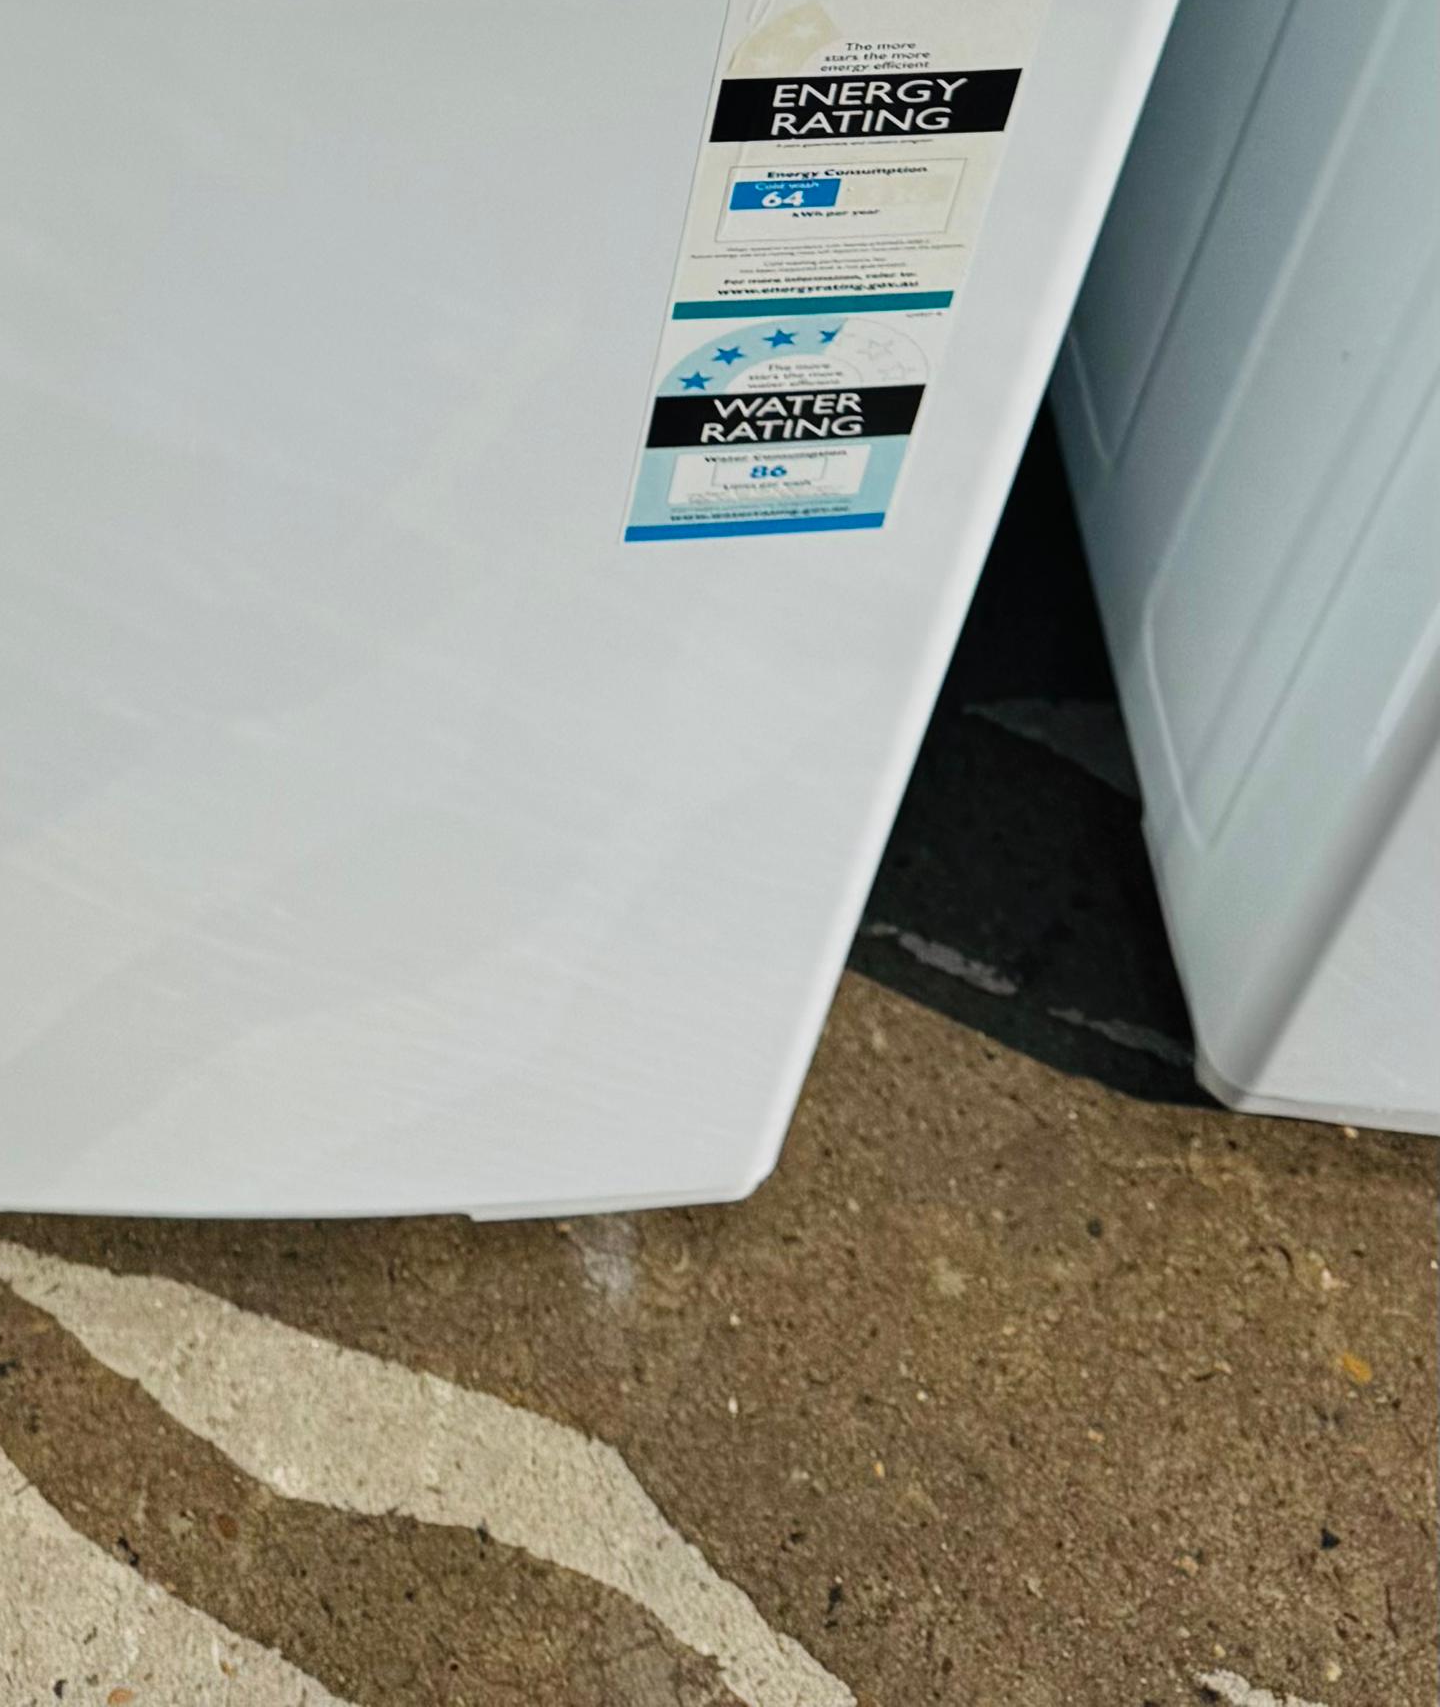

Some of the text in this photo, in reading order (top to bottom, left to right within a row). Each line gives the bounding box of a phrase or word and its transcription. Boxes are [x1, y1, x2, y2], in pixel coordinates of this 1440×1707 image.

[845, 42, 916, 51] The more
[824, 51, 931, 62] stars the more
[820, 61, 930, 72] energy efficient
[771, 78, 968, 108] ENERGY
[770, 107, 952, 136] RATING
[767, 166, 929, 179] Energy Consumption
[761, 190, 805, 207] 64
[713, 392, 863, 419] WATER
[700, 415, 866, 443] RATING
[750, 464, 788, 479] 86
